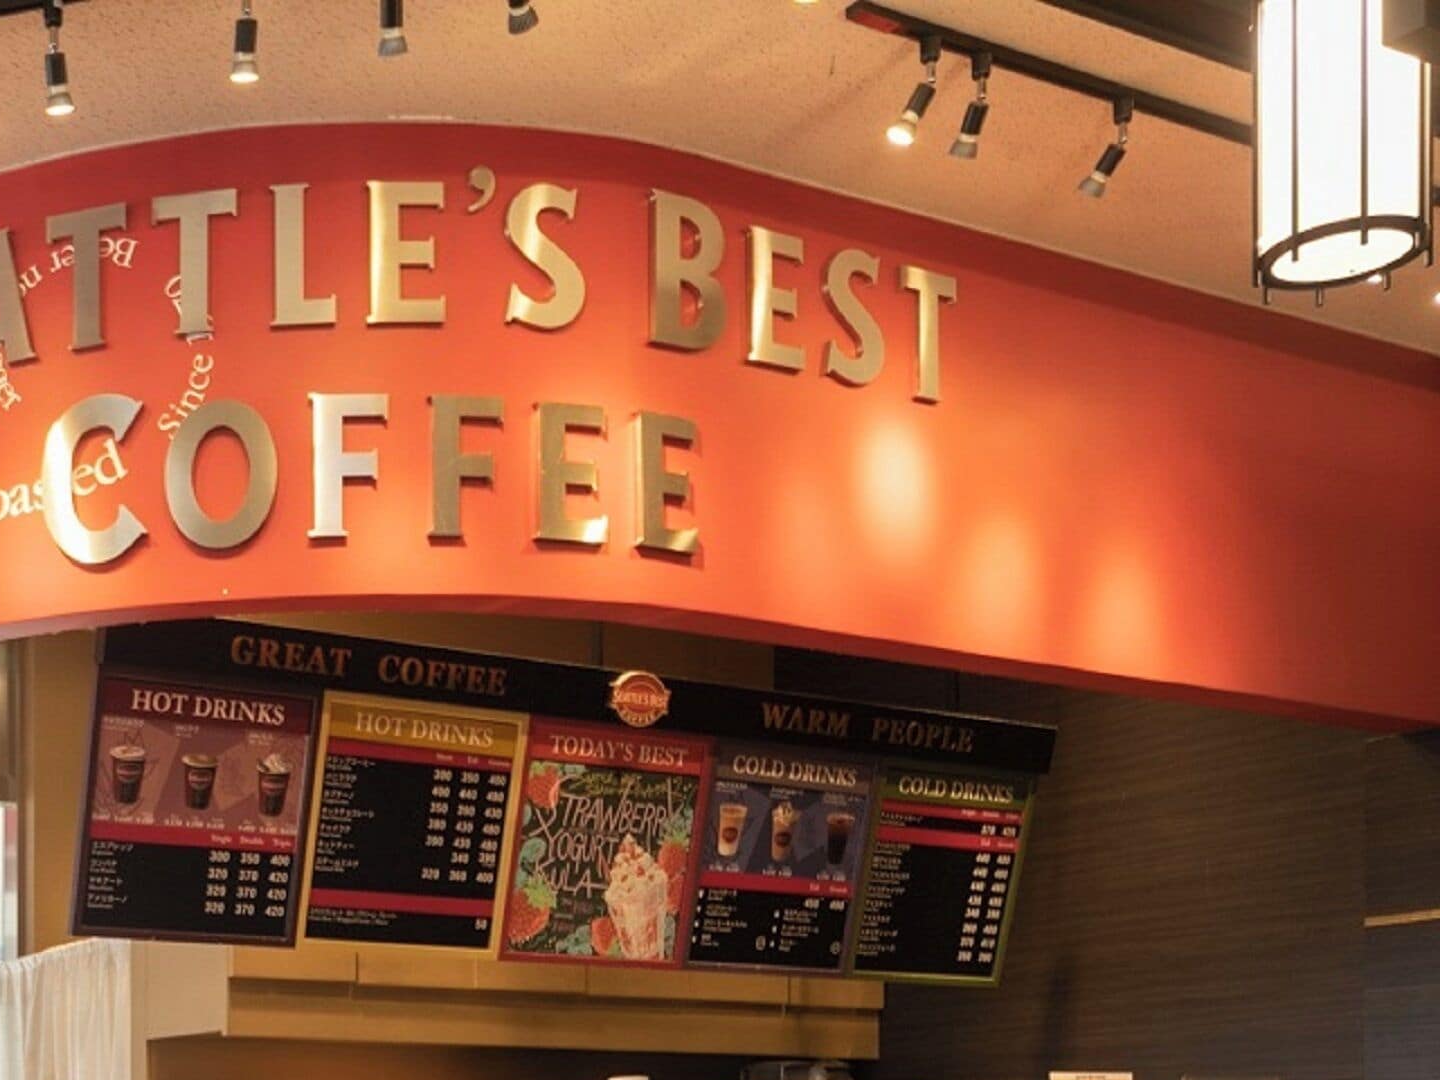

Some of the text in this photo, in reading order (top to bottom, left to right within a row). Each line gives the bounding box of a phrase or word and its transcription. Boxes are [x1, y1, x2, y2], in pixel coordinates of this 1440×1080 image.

[647, 188, 957, 404] BEST
[157, 354, 214, 440] Since
[43, 393, 701, 564] COFFEE
[231, 634, 507, 697] GREAT COFFEE
[131, 689, 285, 726] HOT DRINKS
[356, 712, 494, 748] HOT DRINKS
[762, 702, 974, 753] WARM PEOPLE
[550, 735, 689, 767] TODAY'S BEST
[733, 755, 857, 787] COLD DRINKS
[899, 775, 1014, 804] COLD DRINKS
[538, 818, 619, 878] YOGURT
